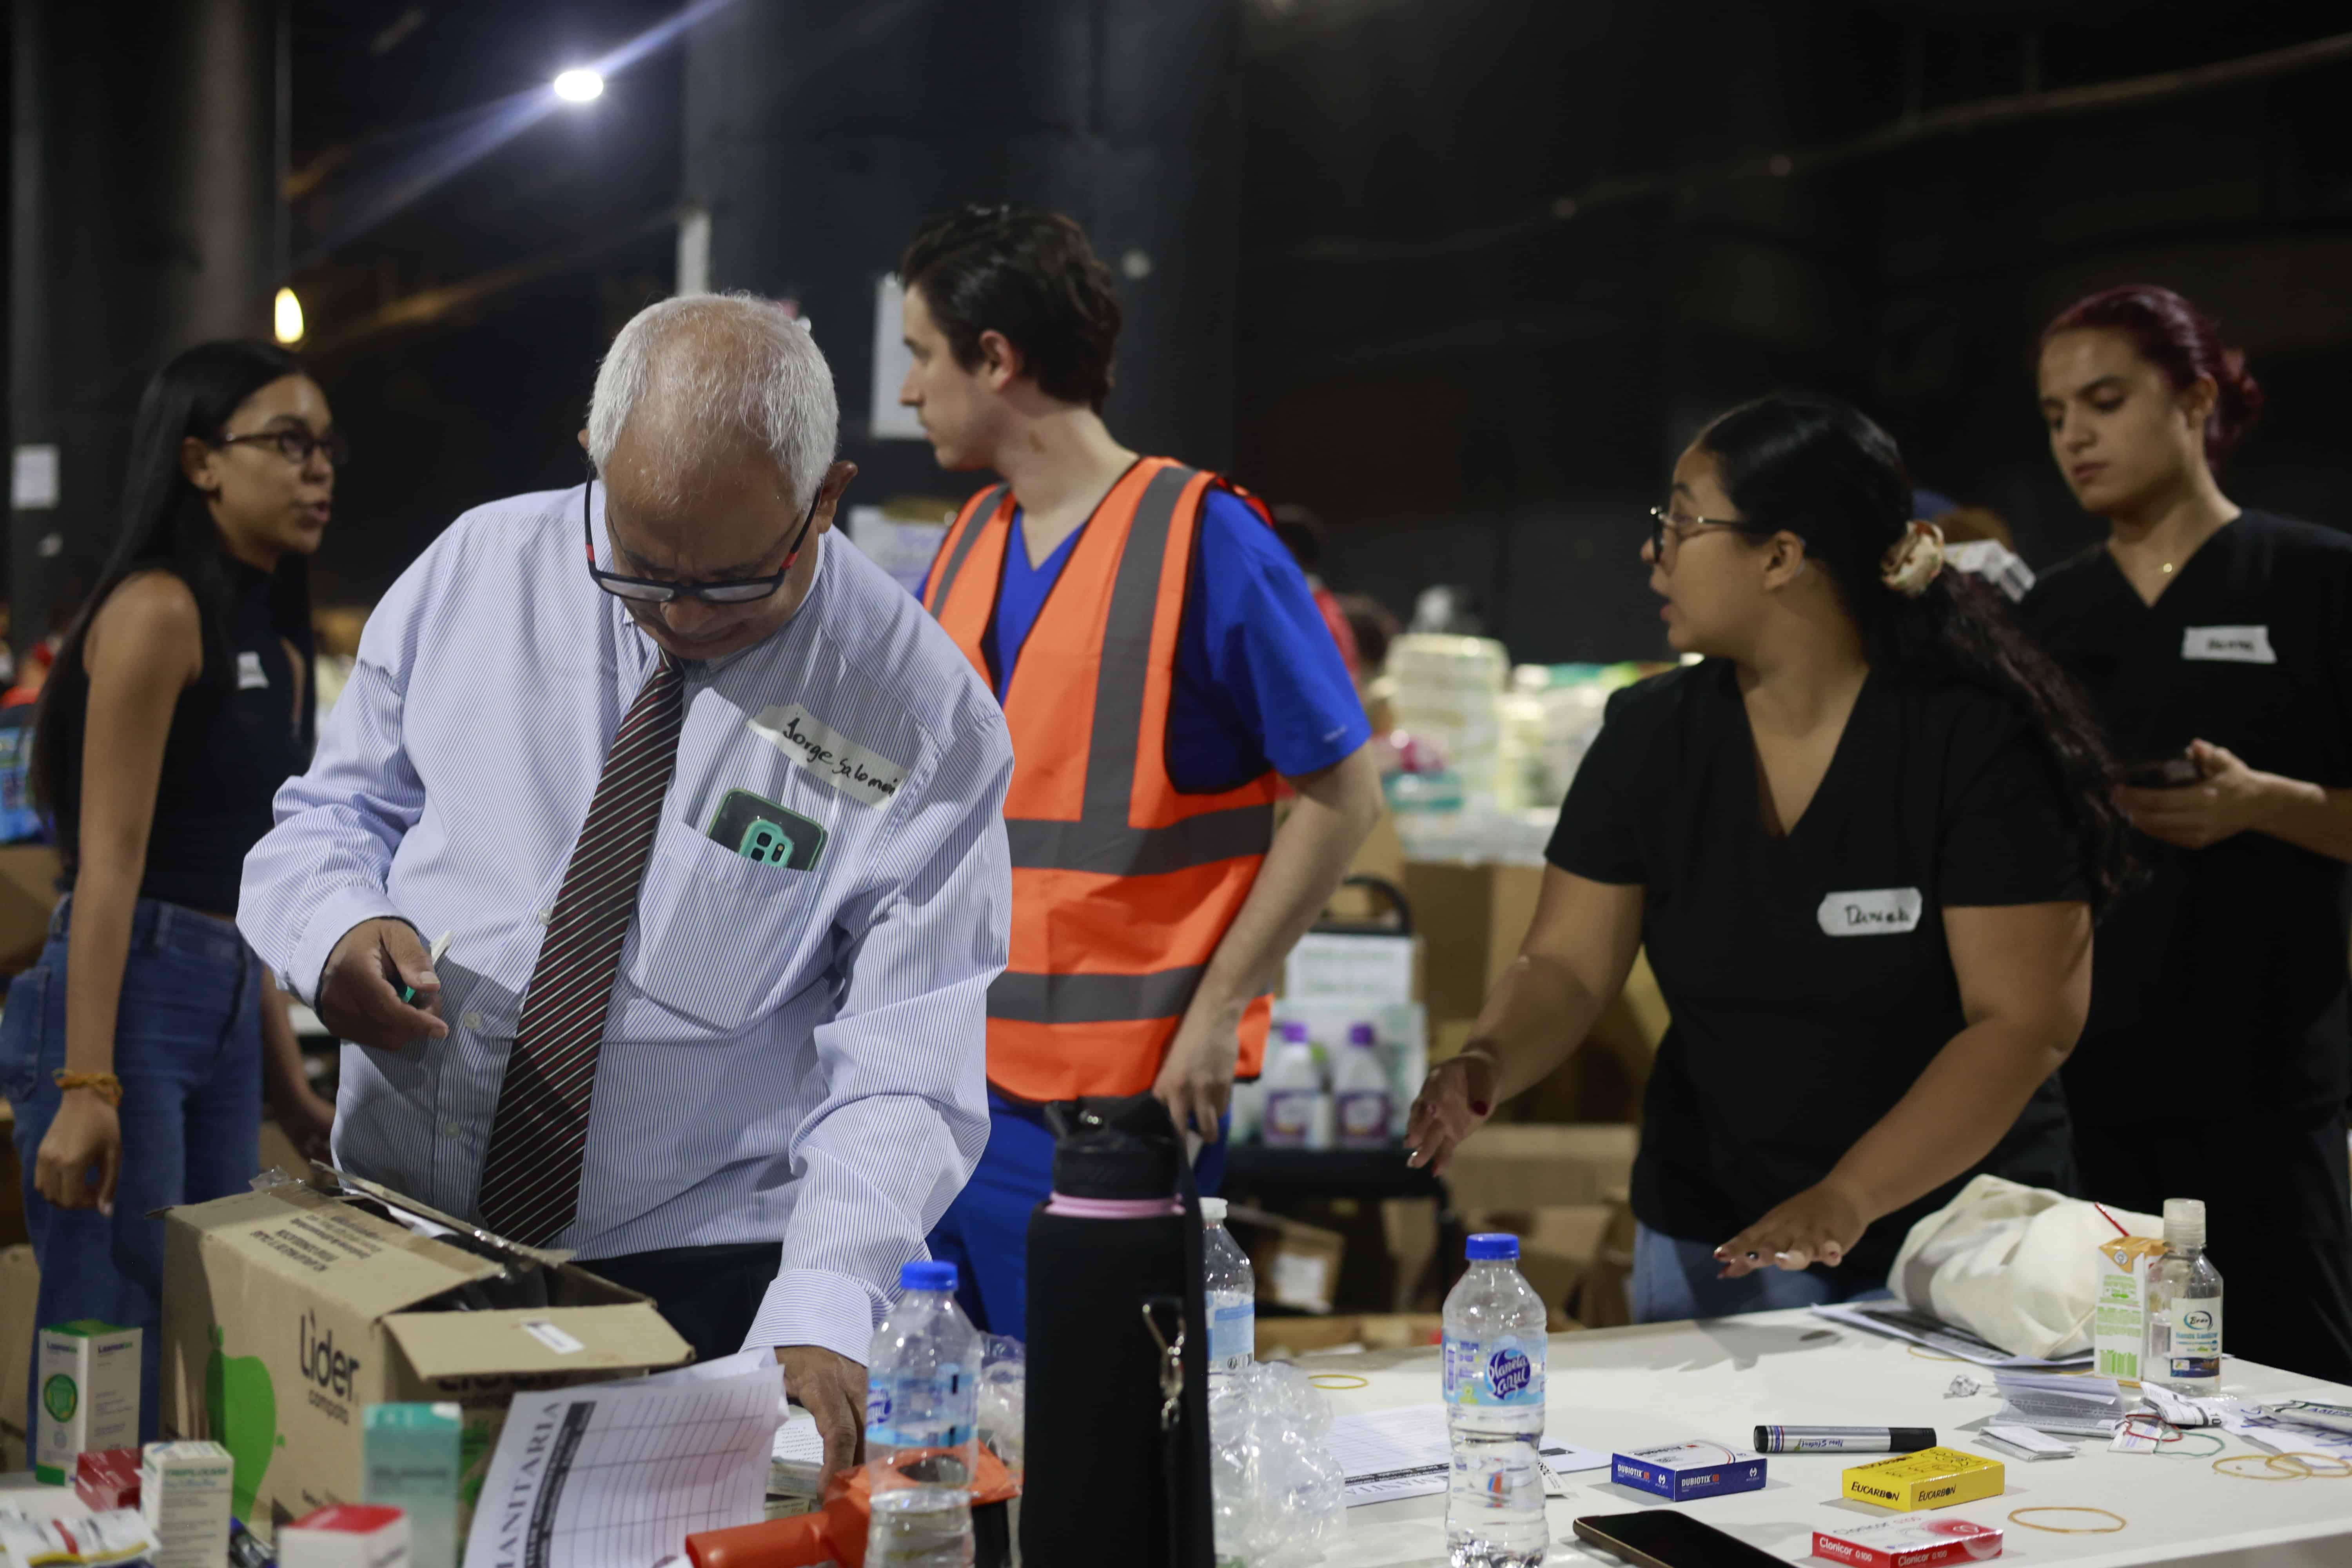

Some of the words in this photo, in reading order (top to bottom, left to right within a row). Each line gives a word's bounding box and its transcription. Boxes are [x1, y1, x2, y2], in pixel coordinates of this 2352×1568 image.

[783, 717, 834, 764] Jorge
[1802, 1439, 1827, 1447] Student
[1617, 1464, 1642, 1478] DUBIOTIX
[1681, 1475, 1711, 1487] DUBIOTIX
[1851, 1481, 1900, 1502] EUCARBON
[1918, 1483, 1957, 1503] EUCARBON
[1819, 1536, 1853, 1556] Clonicor
[1855, 1550, 1873, 1562] 0.100
[1898, 1552, 1929, 1567] Clonicor
[1932, 1550, 1947, 1560] 0.100
